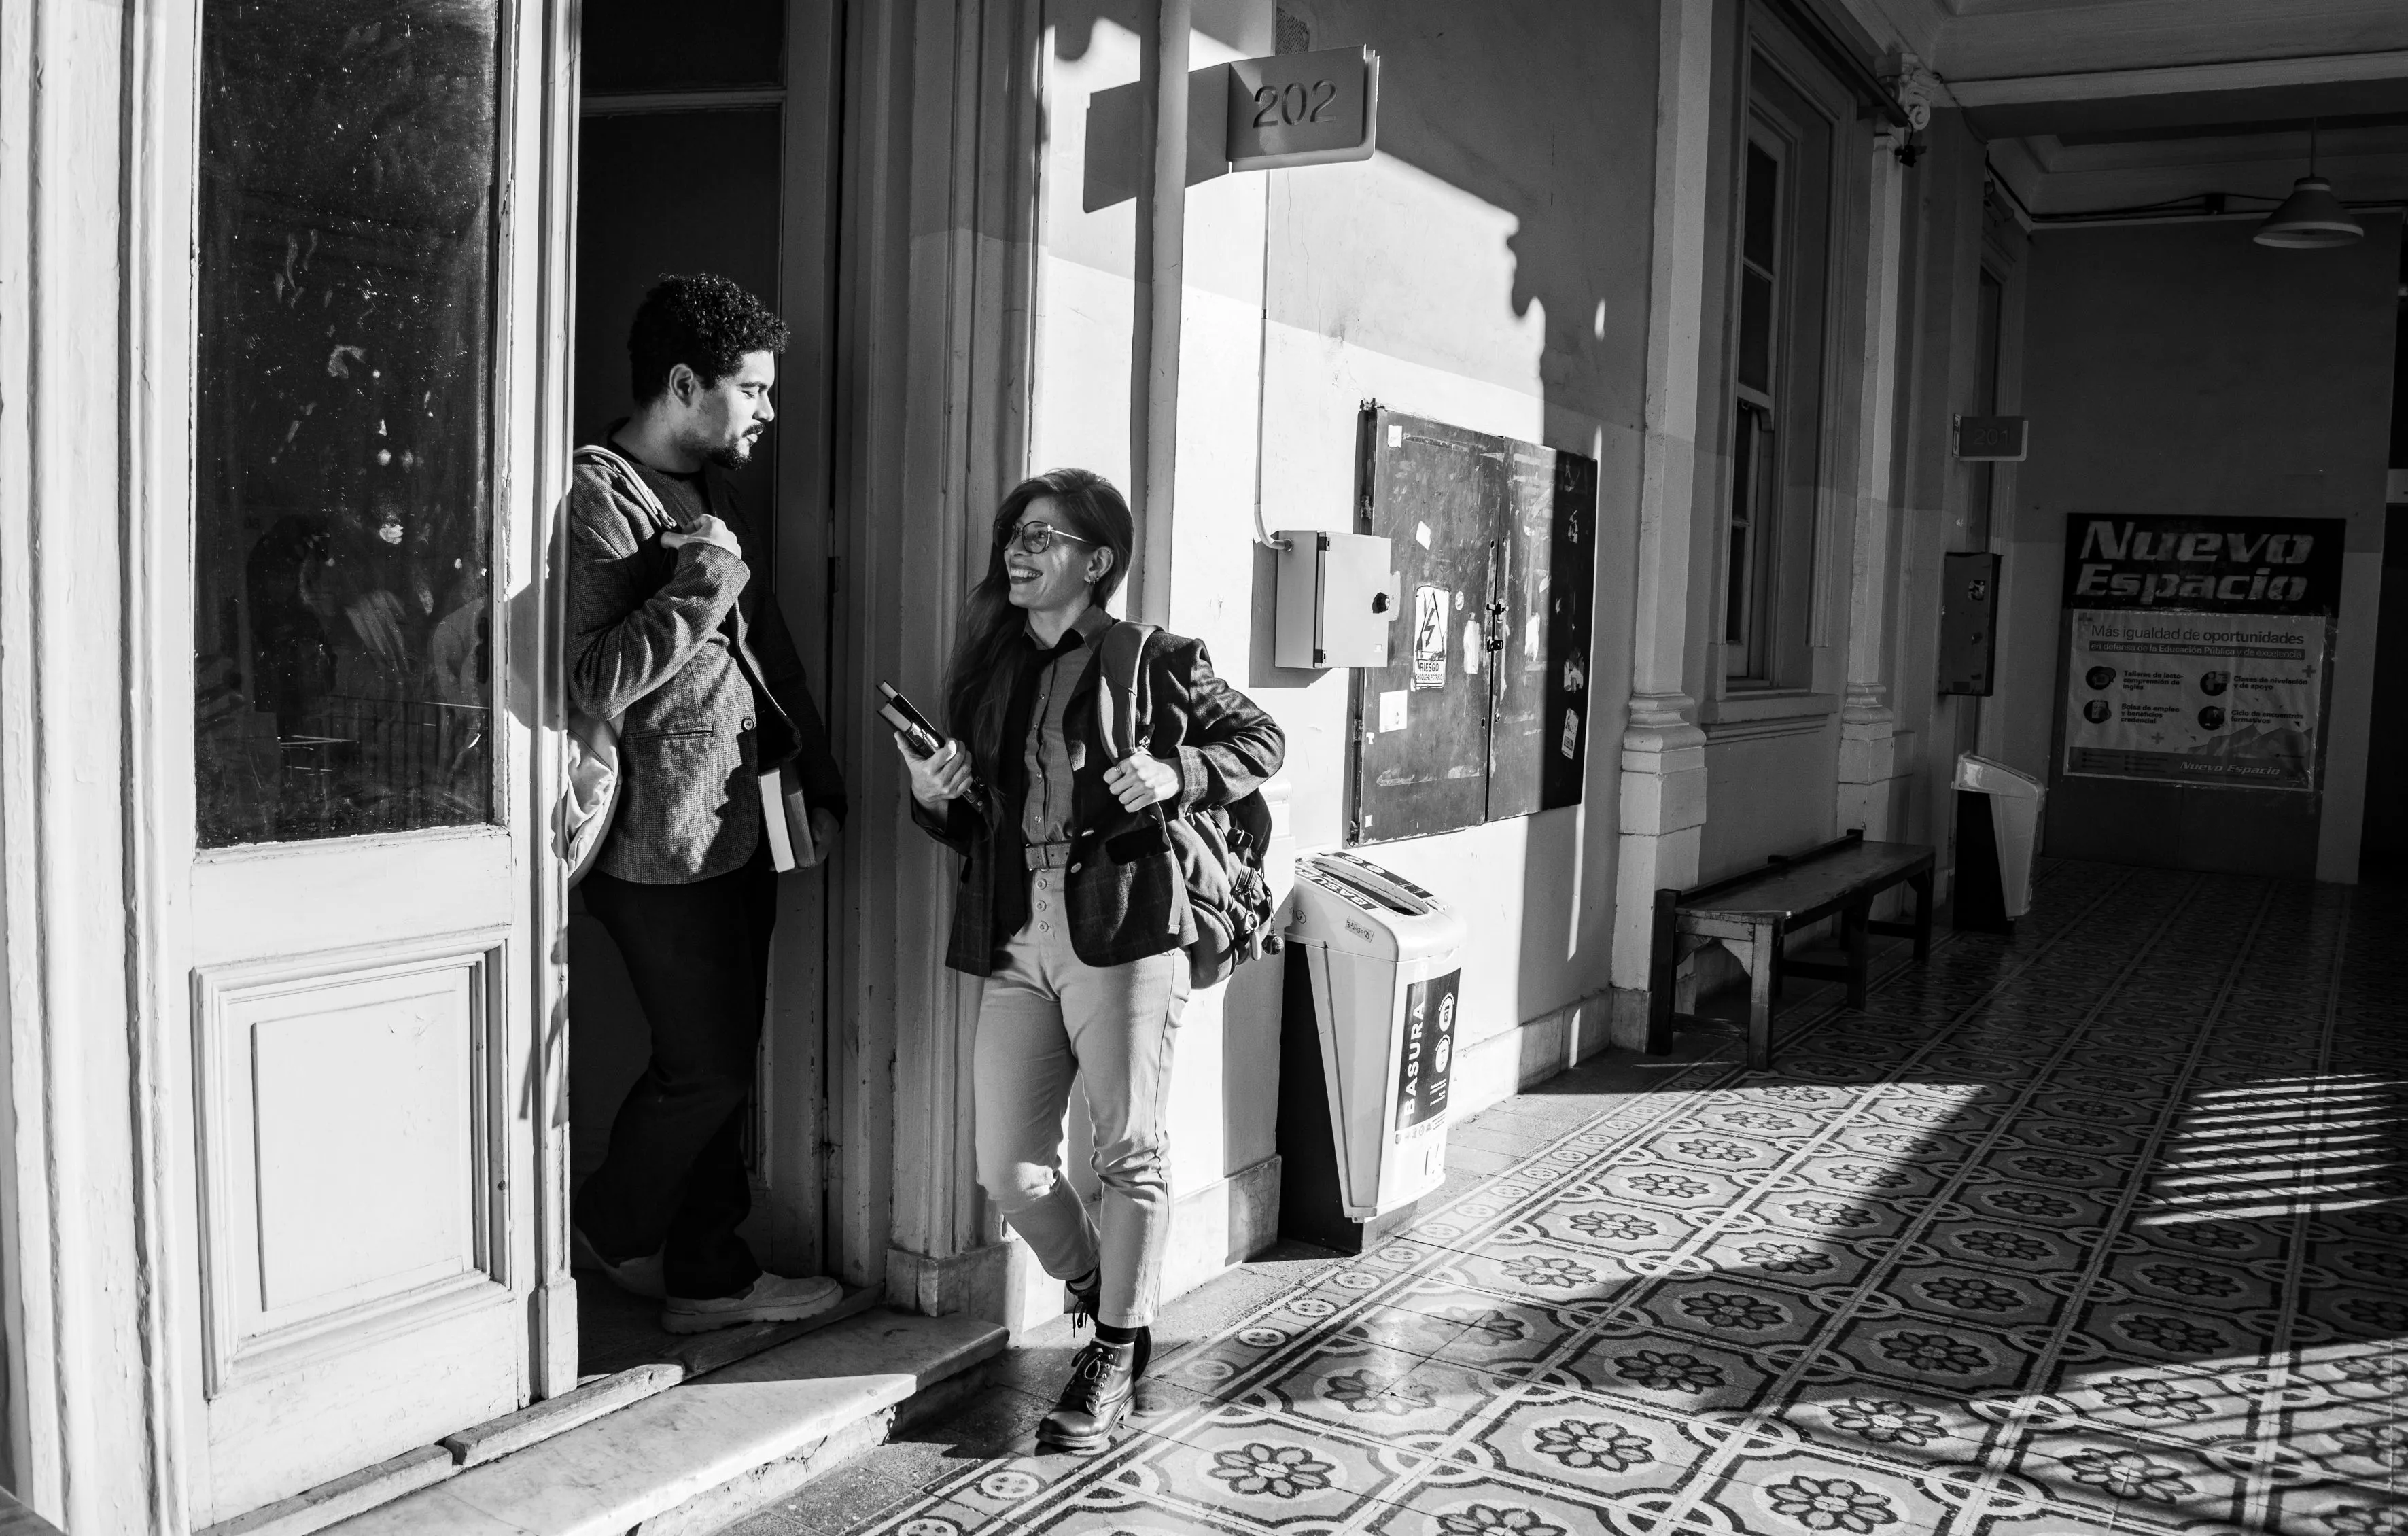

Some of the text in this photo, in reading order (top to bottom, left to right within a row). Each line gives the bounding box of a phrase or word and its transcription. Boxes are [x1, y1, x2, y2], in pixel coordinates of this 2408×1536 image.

[1253, 78, 1338, 128] 202
[1973, 427, 2010, 447] 201
[2078, 520, 2315, 565] Nuevo
[2076, 563, 2309, 605] Espacio
[2091, 625, 2305, 644] Más igualdad de oportunidades
[2103, 642, 2136, 651] defensa
[2137, 644, 2148, 652] de
[2150, 644, 2157, 652] la
[2159, 644, 2203, 654] Educación
[2204, 646, 2235, 656] Pública
[2243, 648, 2255, 657] de
[2256, 649, 2302, 659] excelencia
[1420, 662, 1439, 672] RIESGO
[2123, 678, 2169, 686] comprensión
[2270, 676, 2308, 685] nivelación
[2120, 716, 2157, 725] credencial
[2127, 710, 2163, 718] beneficios
[2231, 709, 2250, 717] Ciclo
[2262, 712, 2304, 720] encuentros
[2231, 716, 2271, 724] formativos
[2180, 761, 2224, 772] Nuevo
[2227, 764, 2281, 775] Espacio
[1403, 1000, 1425, 1117] BASURA
